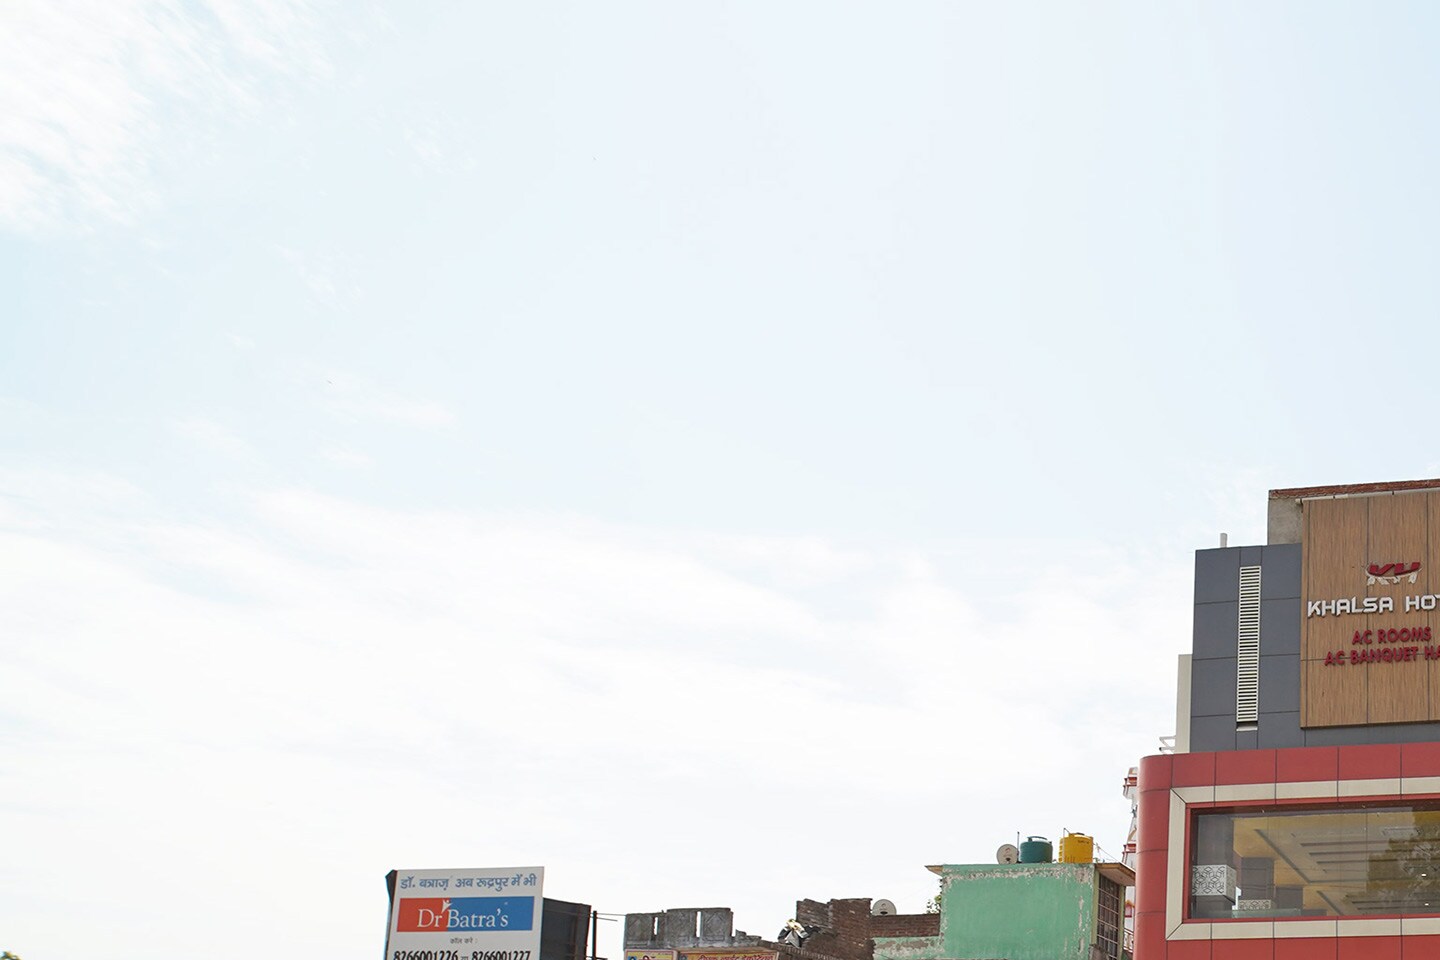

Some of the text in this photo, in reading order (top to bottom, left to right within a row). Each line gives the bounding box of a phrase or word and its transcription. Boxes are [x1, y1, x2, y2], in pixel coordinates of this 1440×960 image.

[1307, 596, 1393, 618] KHALSA
[1352, 626, 1432, 645] AC ROOMS
[1324, 650, 1345, 666] AC
[1350, 646, 1418, 665] BANQUET
[455, 878, 473, 888] अब
[511, 874, 523, 886] में
[523, 873, 537, 886] भी
[417, 908, 509, 928] Dr Batra's
